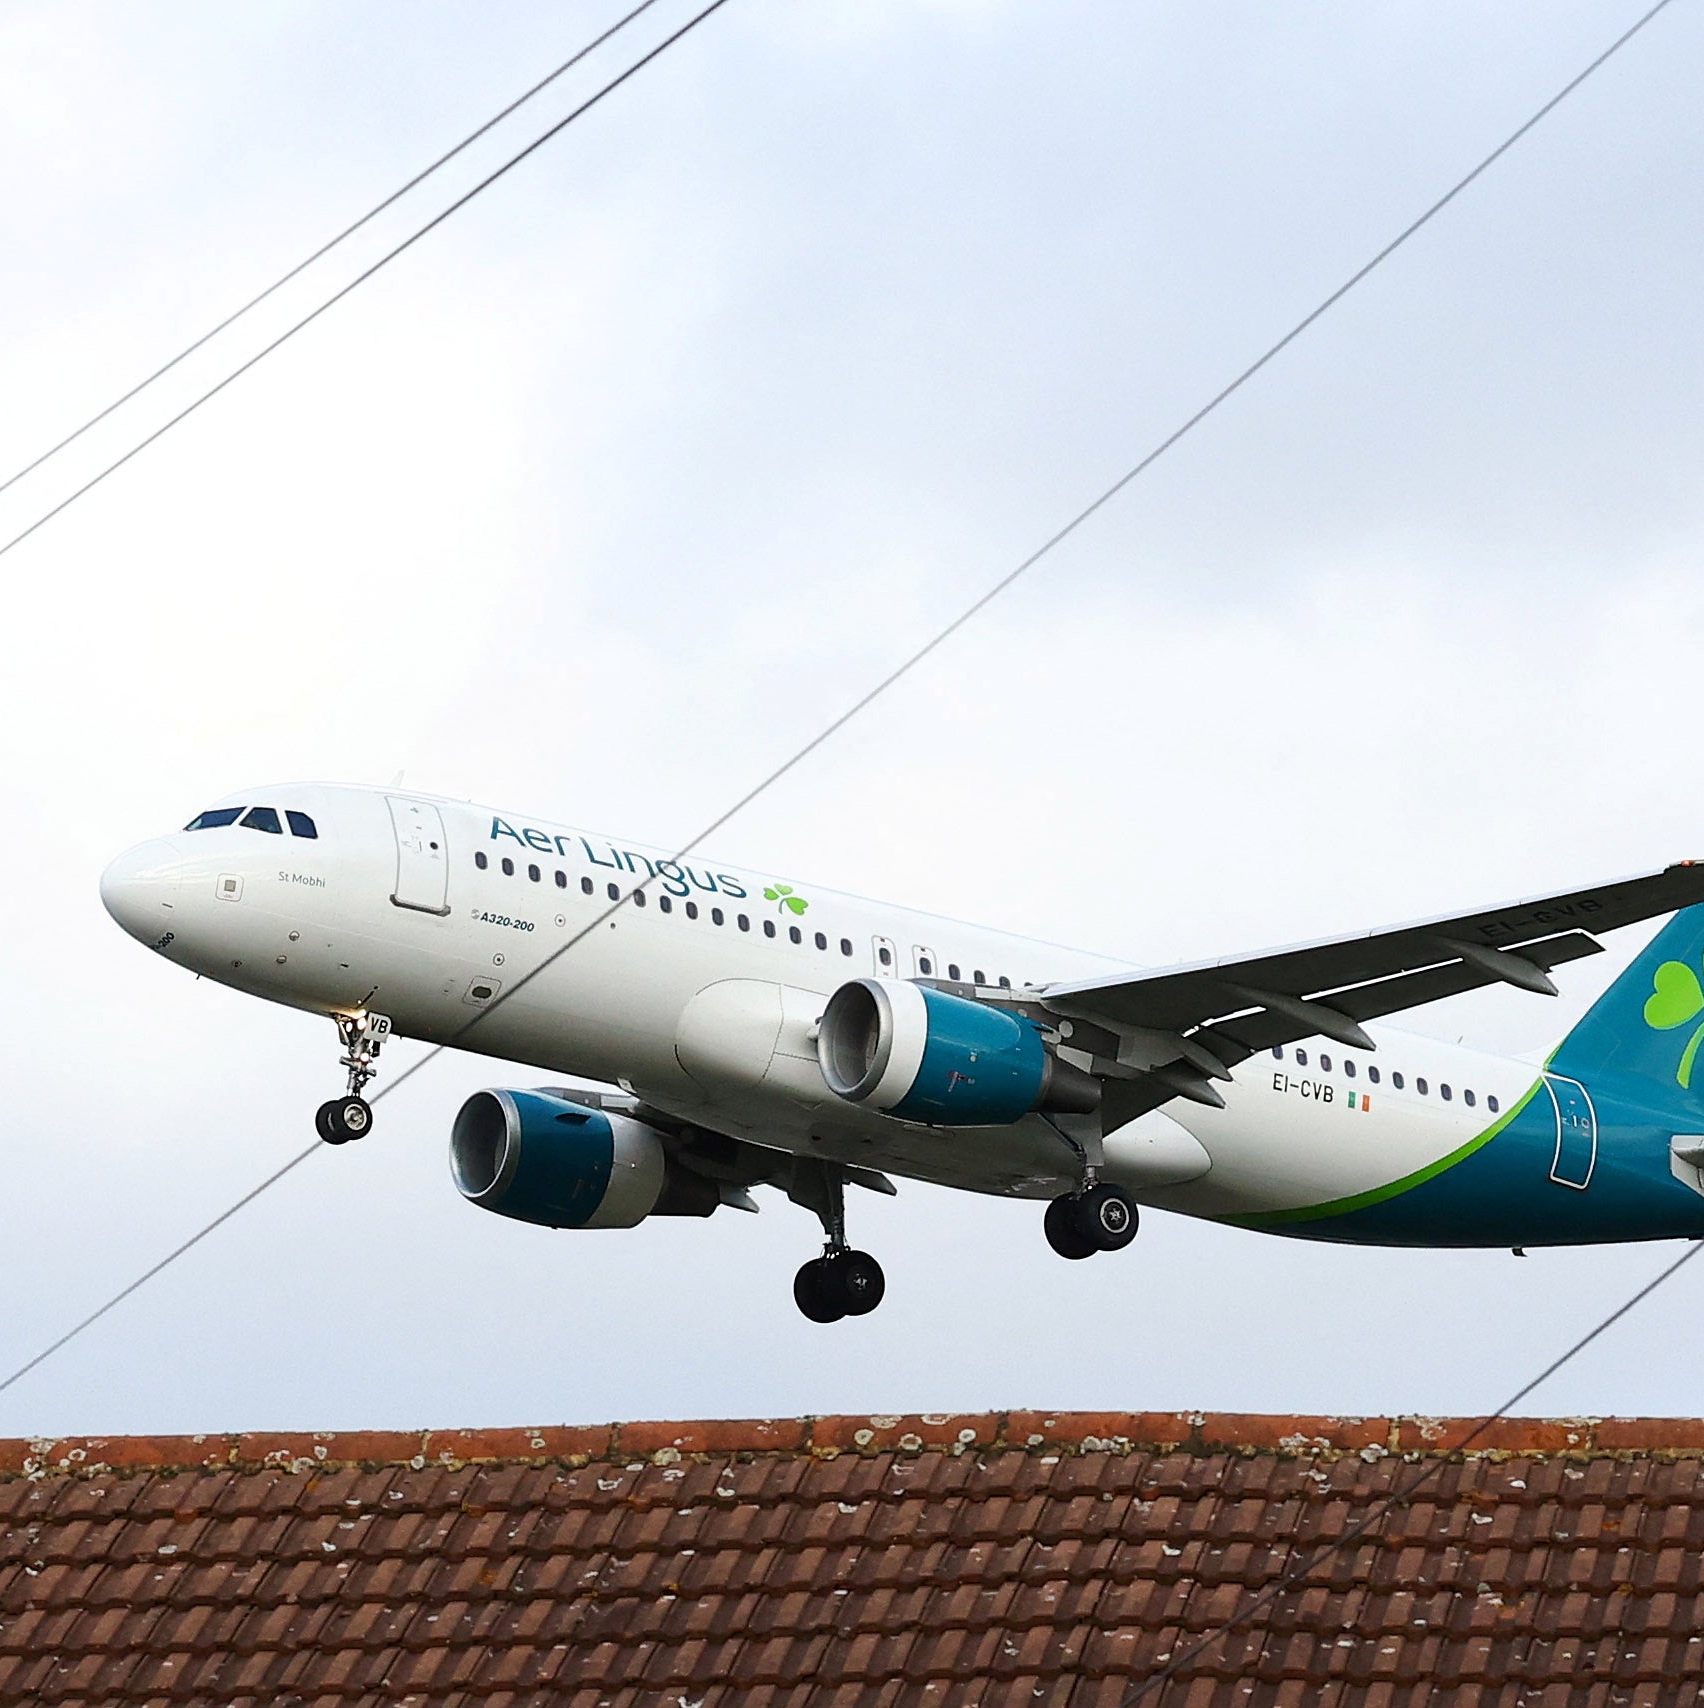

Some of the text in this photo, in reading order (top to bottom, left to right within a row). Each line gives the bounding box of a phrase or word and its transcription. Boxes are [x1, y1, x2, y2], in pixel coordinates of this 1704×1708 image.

[490, 816, 747, 898] Aer Lingus
[278, 871, 326, 888] St Mobhi
[480, 912, 535, 932] A320-200
[1479, 900, 1603, 939] EI-CVB
[370, 1017, 389, 1034] VB
[1273, 1072, 1334, 1103] EI-CVB
